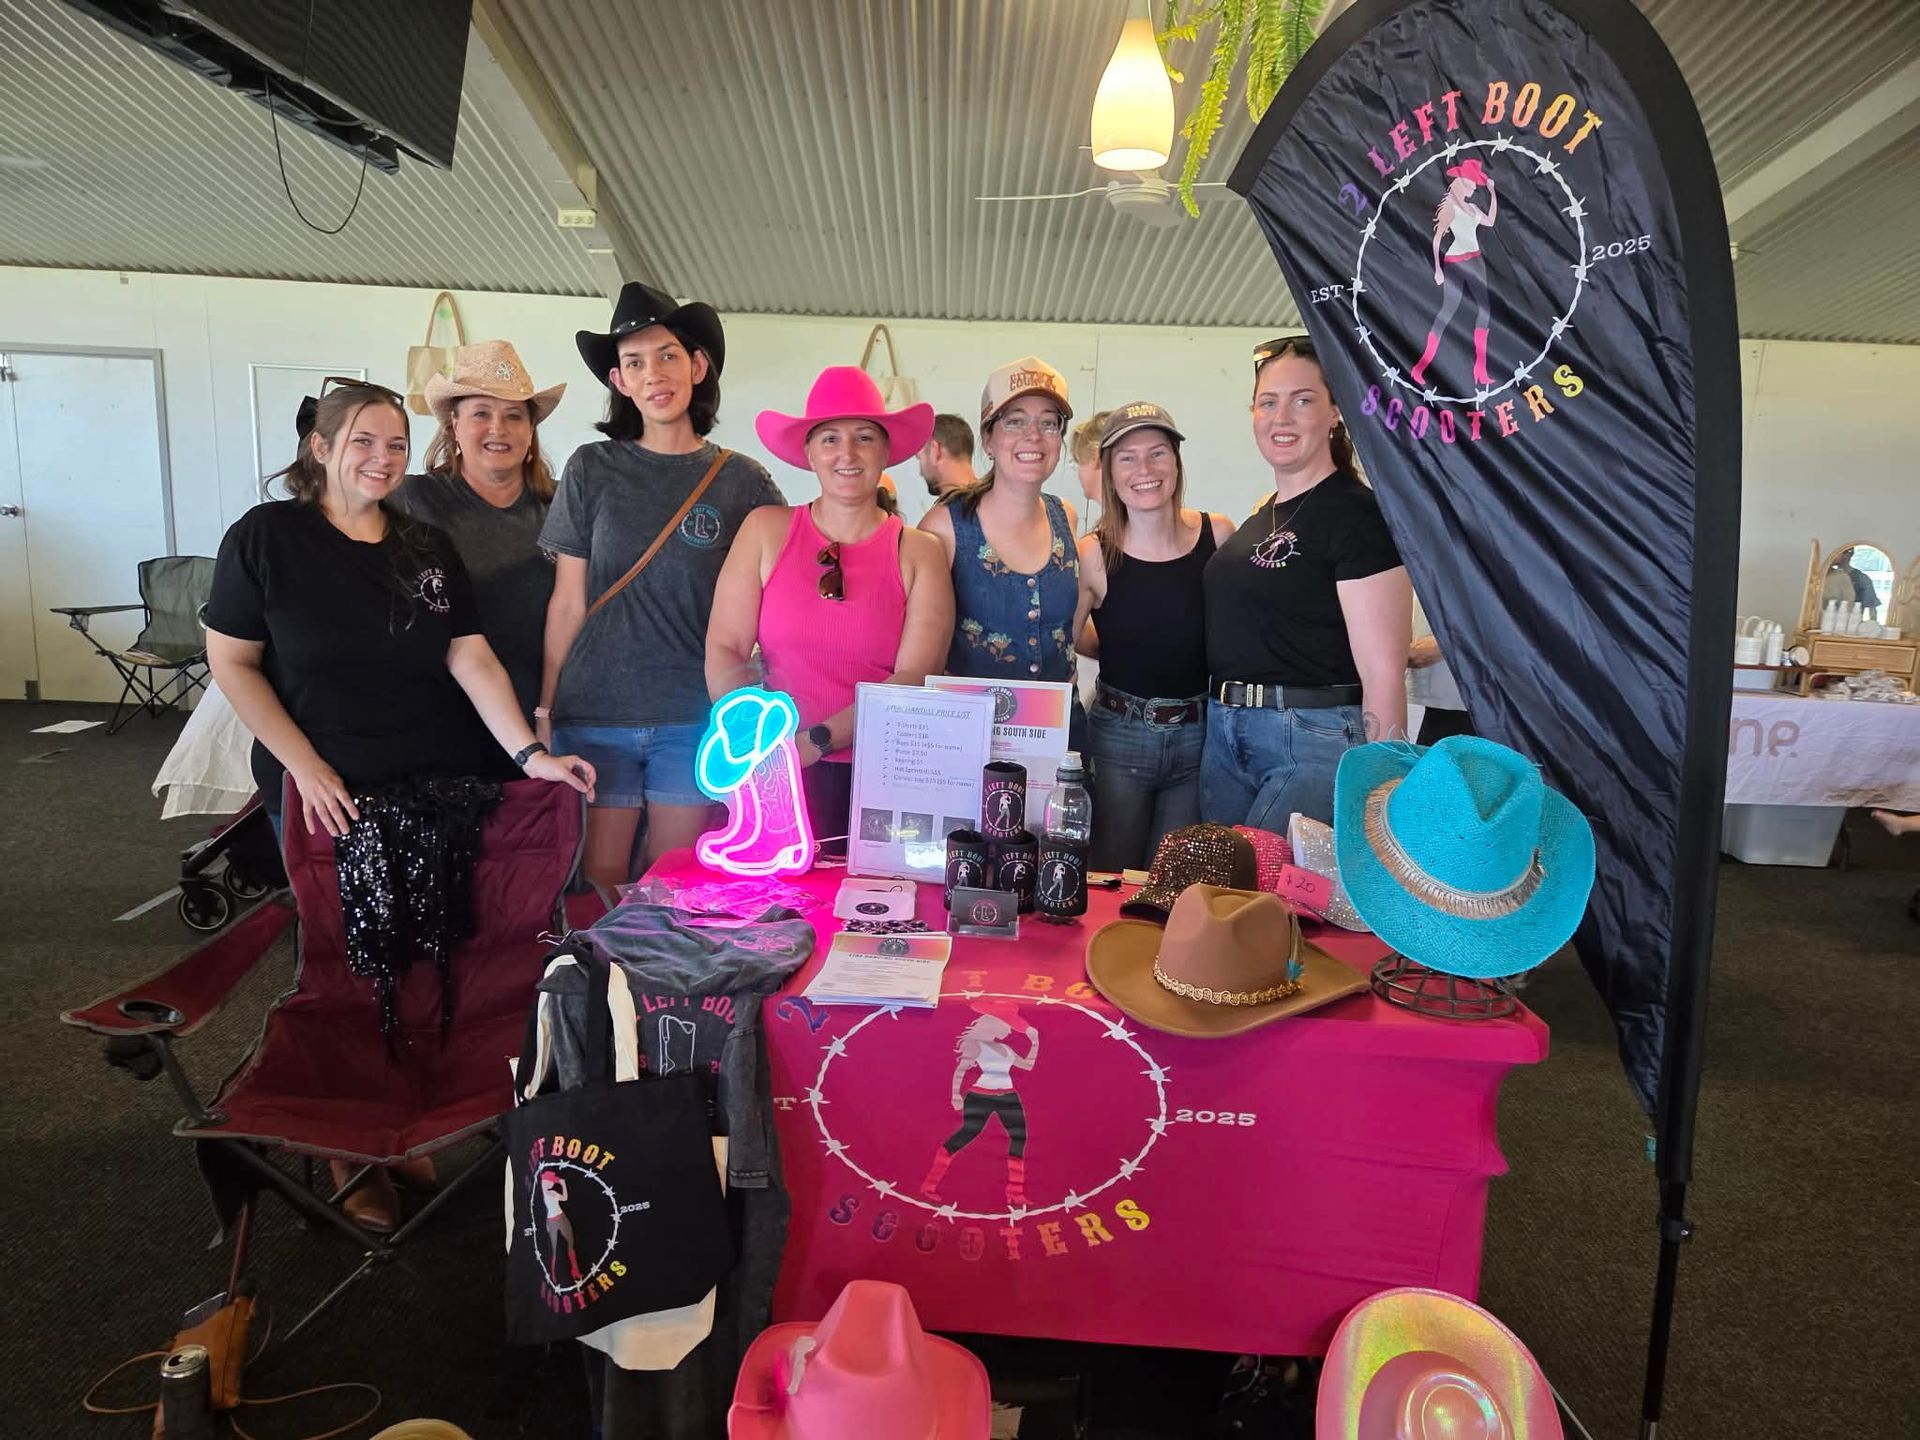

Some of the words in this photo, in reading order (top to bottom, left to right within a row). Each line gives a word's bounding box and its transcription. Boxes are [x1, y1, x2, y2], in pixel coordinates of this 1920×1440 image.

[1337, 182, 1369, 217] 2
[1366, 90, 1462, 178] LEFT
[1481, 81, 1604, 154] BOOT
[1592, 234, 1652, 262] 2025
[1311, 283, 1345, 304] EST
[1360, 364, 1585, 445] SCOOTERS
[1003, 726, 1027, 738] SOUTH
[1029, 728, 1047, 739] SIDE
[777, 995, 831, 1035] 2
[1175, 1108, 1257, 1127] 2025
[551, 1135, 615, 1171] BOOT
[620, 1201, 651, 1214] 2025
[828, 1197, 1151, 1262] SCOOTERS
